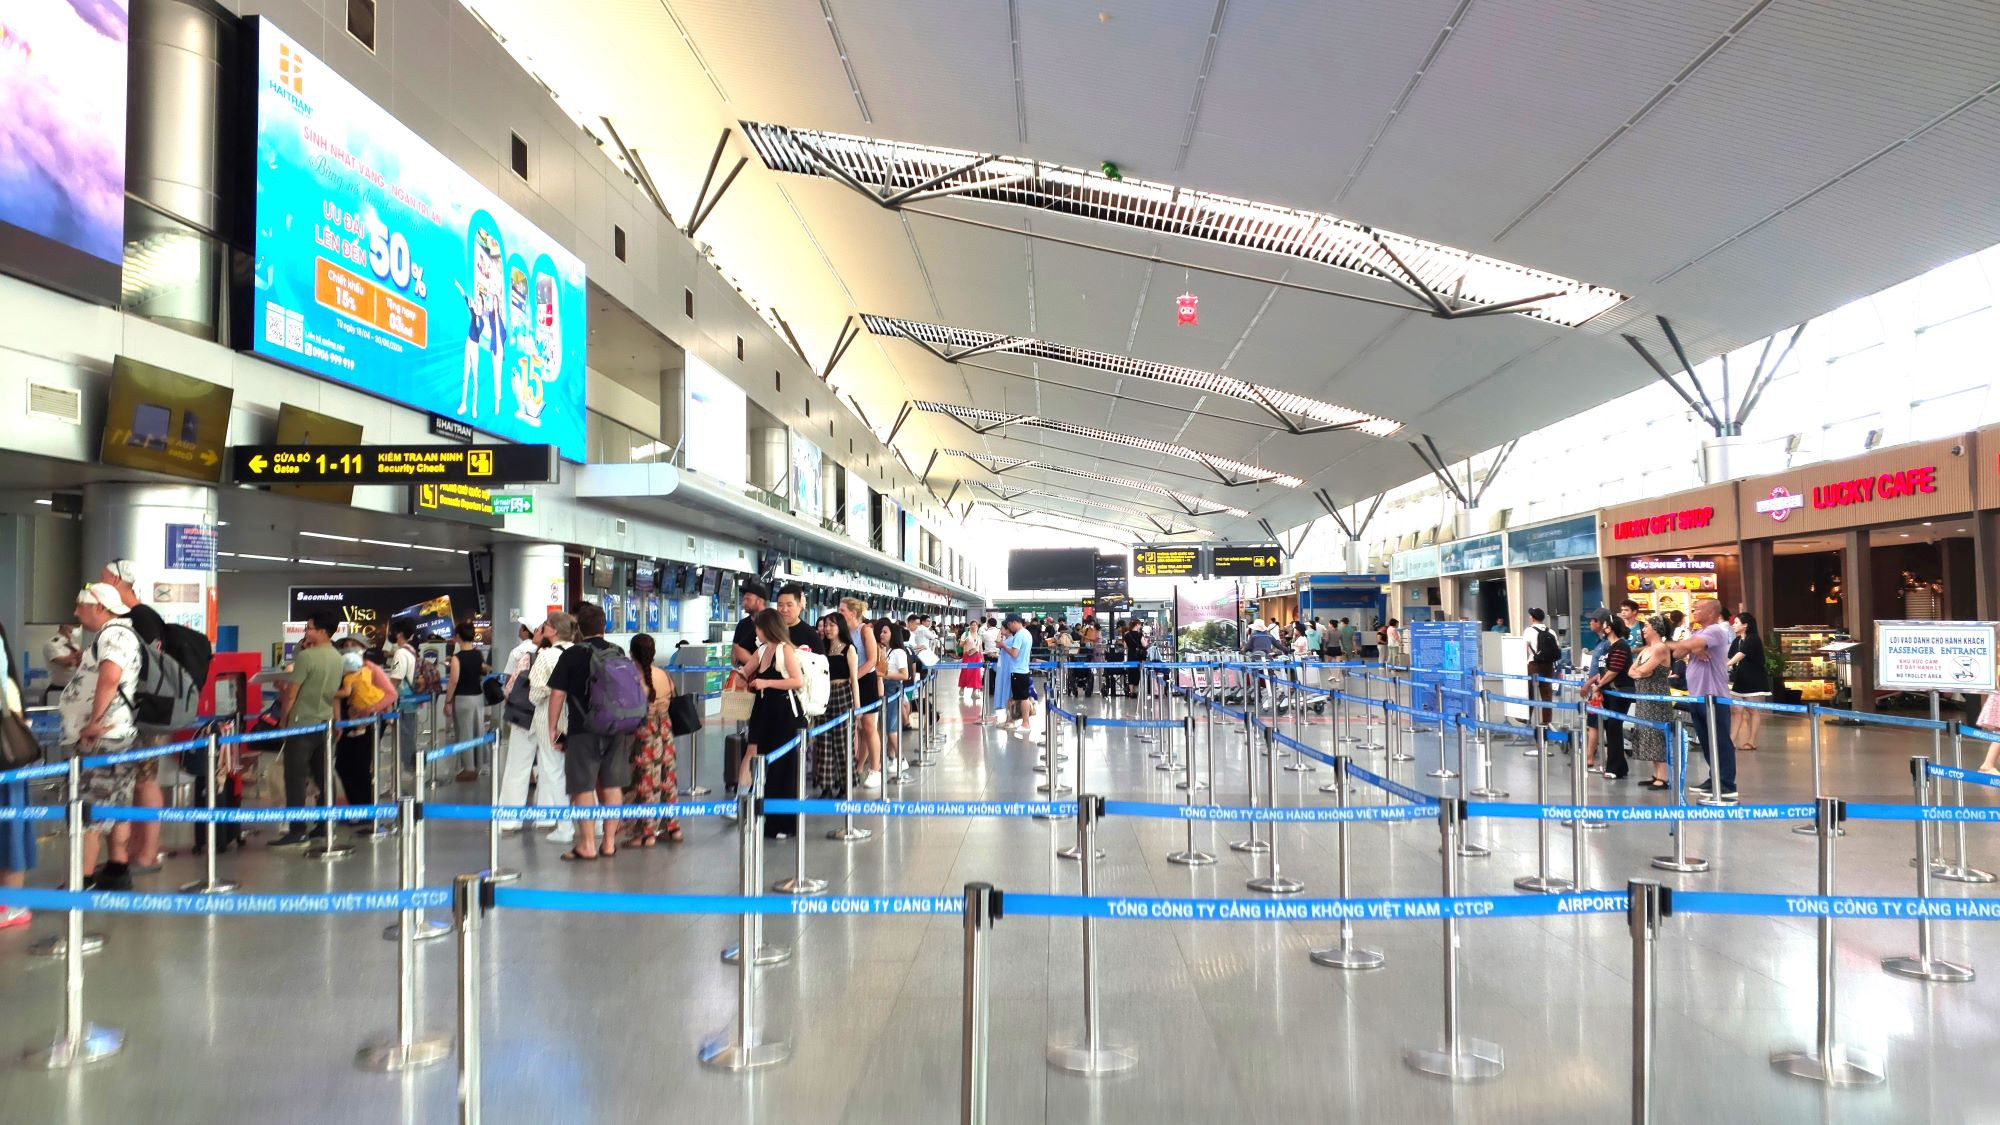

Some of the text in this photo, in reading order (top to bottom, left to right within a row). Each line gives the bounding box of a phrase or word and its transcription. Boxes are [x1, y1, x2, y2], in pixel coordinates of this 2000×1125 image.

[304, 125, 328, 151] SINH
[315, 223, 367, 267] LÊN ĐẾN
[335, 286, 357, 312] 15%
[518, 353, 544, 406] 15
[441, 419, 472, 438] HAITRAN
[274, 452, 295, 463] CỬA
[378, 451, 464, 462] KIỂM TRA AN NINH
[273, 464, 300, 474] Gates
[378, 463, 446, 475] Security Check
[1813, 476, 1876, 510] LUCKY
[1876, 466, 1937, 500] CAFE
[494, 505, 510, 513] EXIT
[1614, 506, 1714, 540] LUCKY GIFT SHOP
[1630, 559, 1648, 570] ĐẶC
[1648, 557, 1665, 569] SẢN
[1686, 560, 1715, 570] TRUNG
[297, 591, 344, 601] Sacombank
[342, 605, 377, 622] Visa
[627, 603, 637, 623] N2
[650, 604, 658, 622] N3
[670, 605, 678, 621] N4
[432, 627, 451, 636] VISA
[1932, 636, 1943, 645] CHO
[1888, 646, 1988, 656] PASSENGER ENTRANCE
[1930, 766, 1965, 779] NAM CTCP
[344, 807, 368, 819] NAM
[491, 804, 705, 819] TỔNG CÔNG TY CẢNG HÀNG KHÔNG VIỆT NAM
[834, 801, 1051, 816] TỔNG CÔNG TY CẢNG HÀNG KHÔNG VIỆT NAM
[1179, 806, 1440, 821] TỔNG CÔNG TY CẢNG HÀNG KHÔNG VIỆT NAM CTCP
[1542, 806, 1816, 820] TỔNG CÔNG TY CẢNG HÀNG KHÔNG VIỆT NAM CTCP
[1922, 807, 1953, 820] TỔNG
[1955, 808, 1987, 820] CÔNG
[92, 891, 448, 911] TỔNG CÔNG TY CẢNG HÀNG KHÔNG VIỆT NAM CTCP
[873, 898, 890, 913] TY
[1786, 897, 2000, 917] TỔNG CÔNG TY CẢNG HÀNG
[1107, 898, 1495, 920] TỔNG CÔNG TY CẢNG HÀNG KHÔNG VIỆT NAM CTCP
